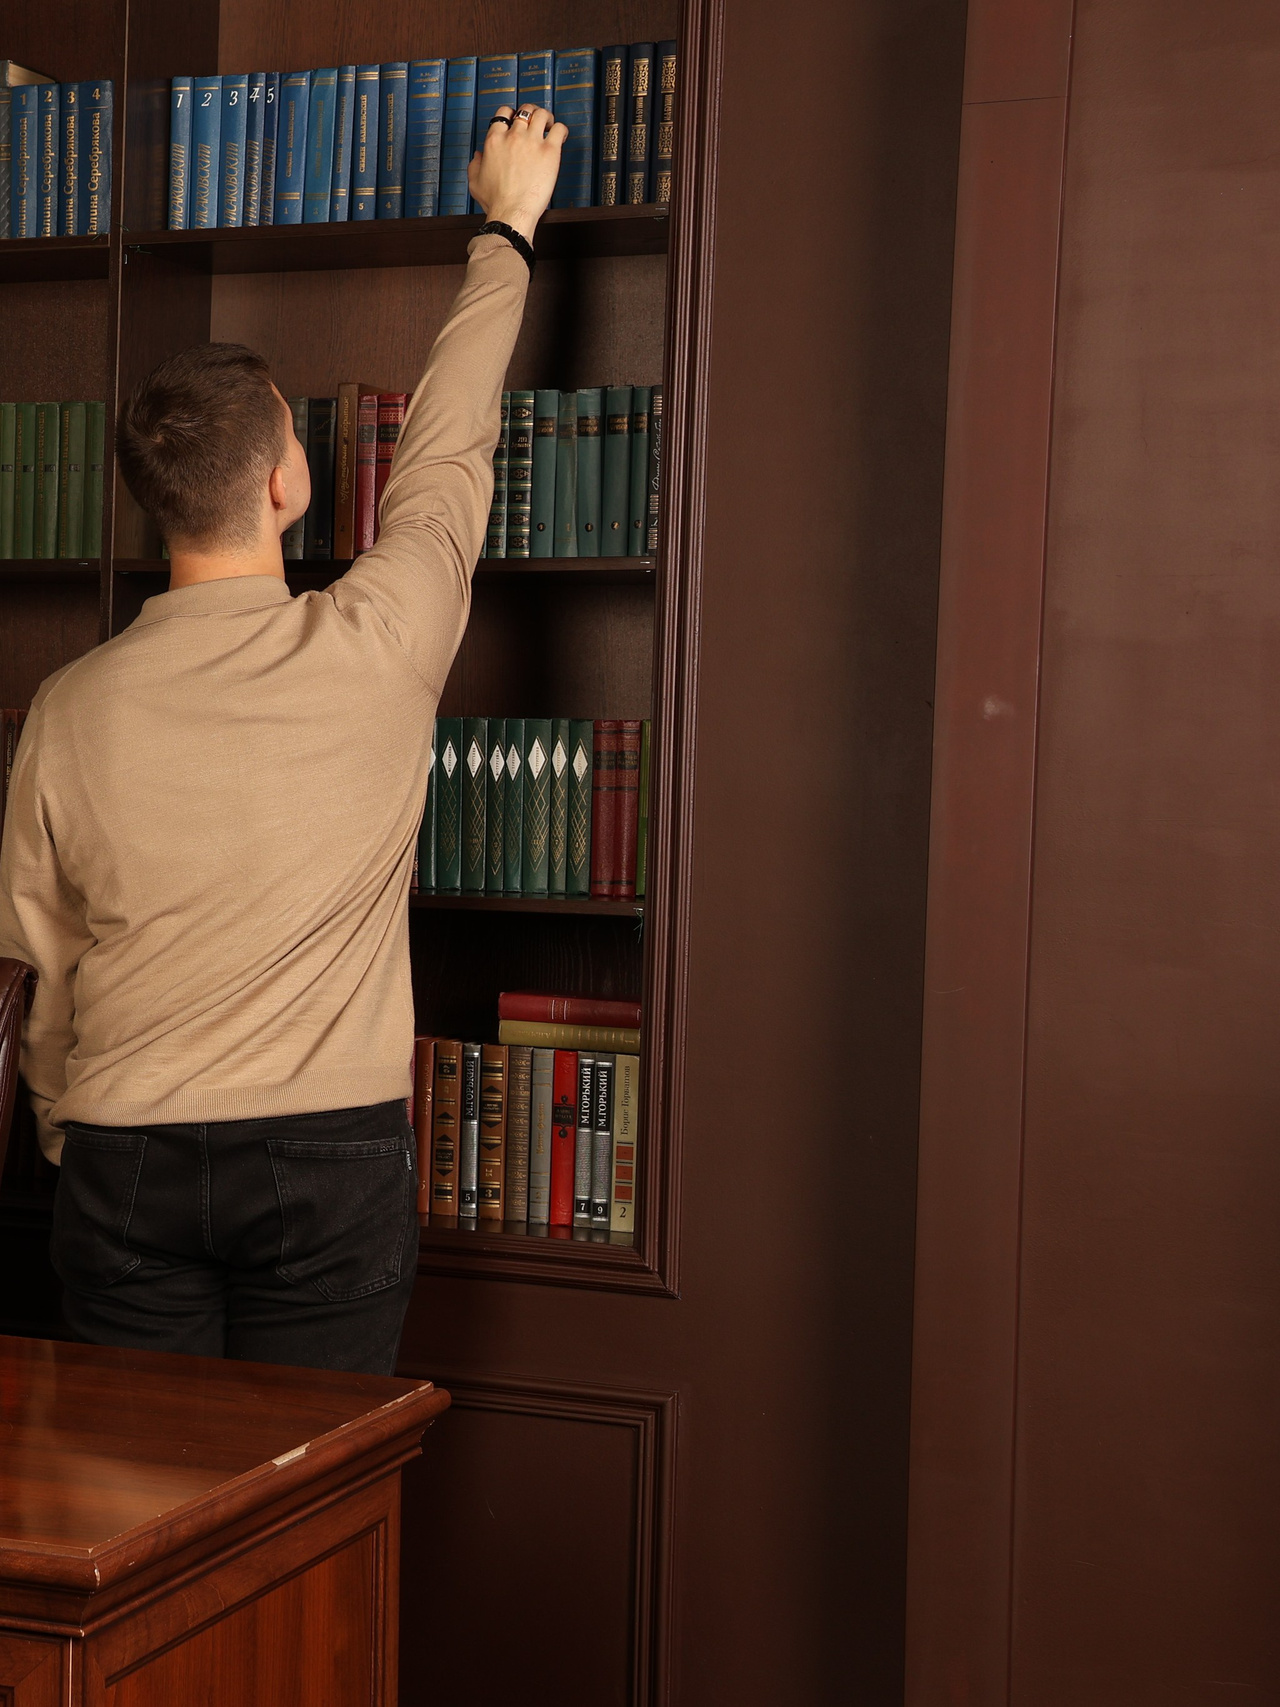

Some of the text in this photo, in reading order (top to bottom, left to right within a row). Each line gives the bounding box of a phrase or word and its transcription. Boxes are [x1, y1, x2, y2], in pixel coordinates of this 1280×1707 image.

[20, 94, 26, 104] 1
[44, 90, 52, 102] 2
[67, 92, 75, 103] 3
[92, 88, 100, 100] 4
[177, 93, 183, 108] 1
[202, 92, 212, 106] 2
[230, 91, 238, 105] 3
[249, 87, 260, 102] 4
[267, 87, 274, 103] 5
[16, 118, 30, 195] Серебрякова
[41, 114, 54, 193] Серебрякова
[88, 113, 102, 191] Серебрякова
[63, 116, 77, 235] алина Серебрякова
[359, 202, 364, 210] 5
[466, 1060, 474, 1116] М.ГОРЬКИЙ
[581, 1067, 591, 1124] М.ГОРЬКИЙ
[598, 1070, 607, 1127] М.ГОРЬКИЙ
[621, 1109, 629, 1135] Борис
[466, 1193, 470, 1201] 5
[485, 1189, 493, 1198] 3
[581, 1202, 585, 1211] 7
[598, 1206, 603, 1214] 9
[620, 1207, 626, 1218] 2
